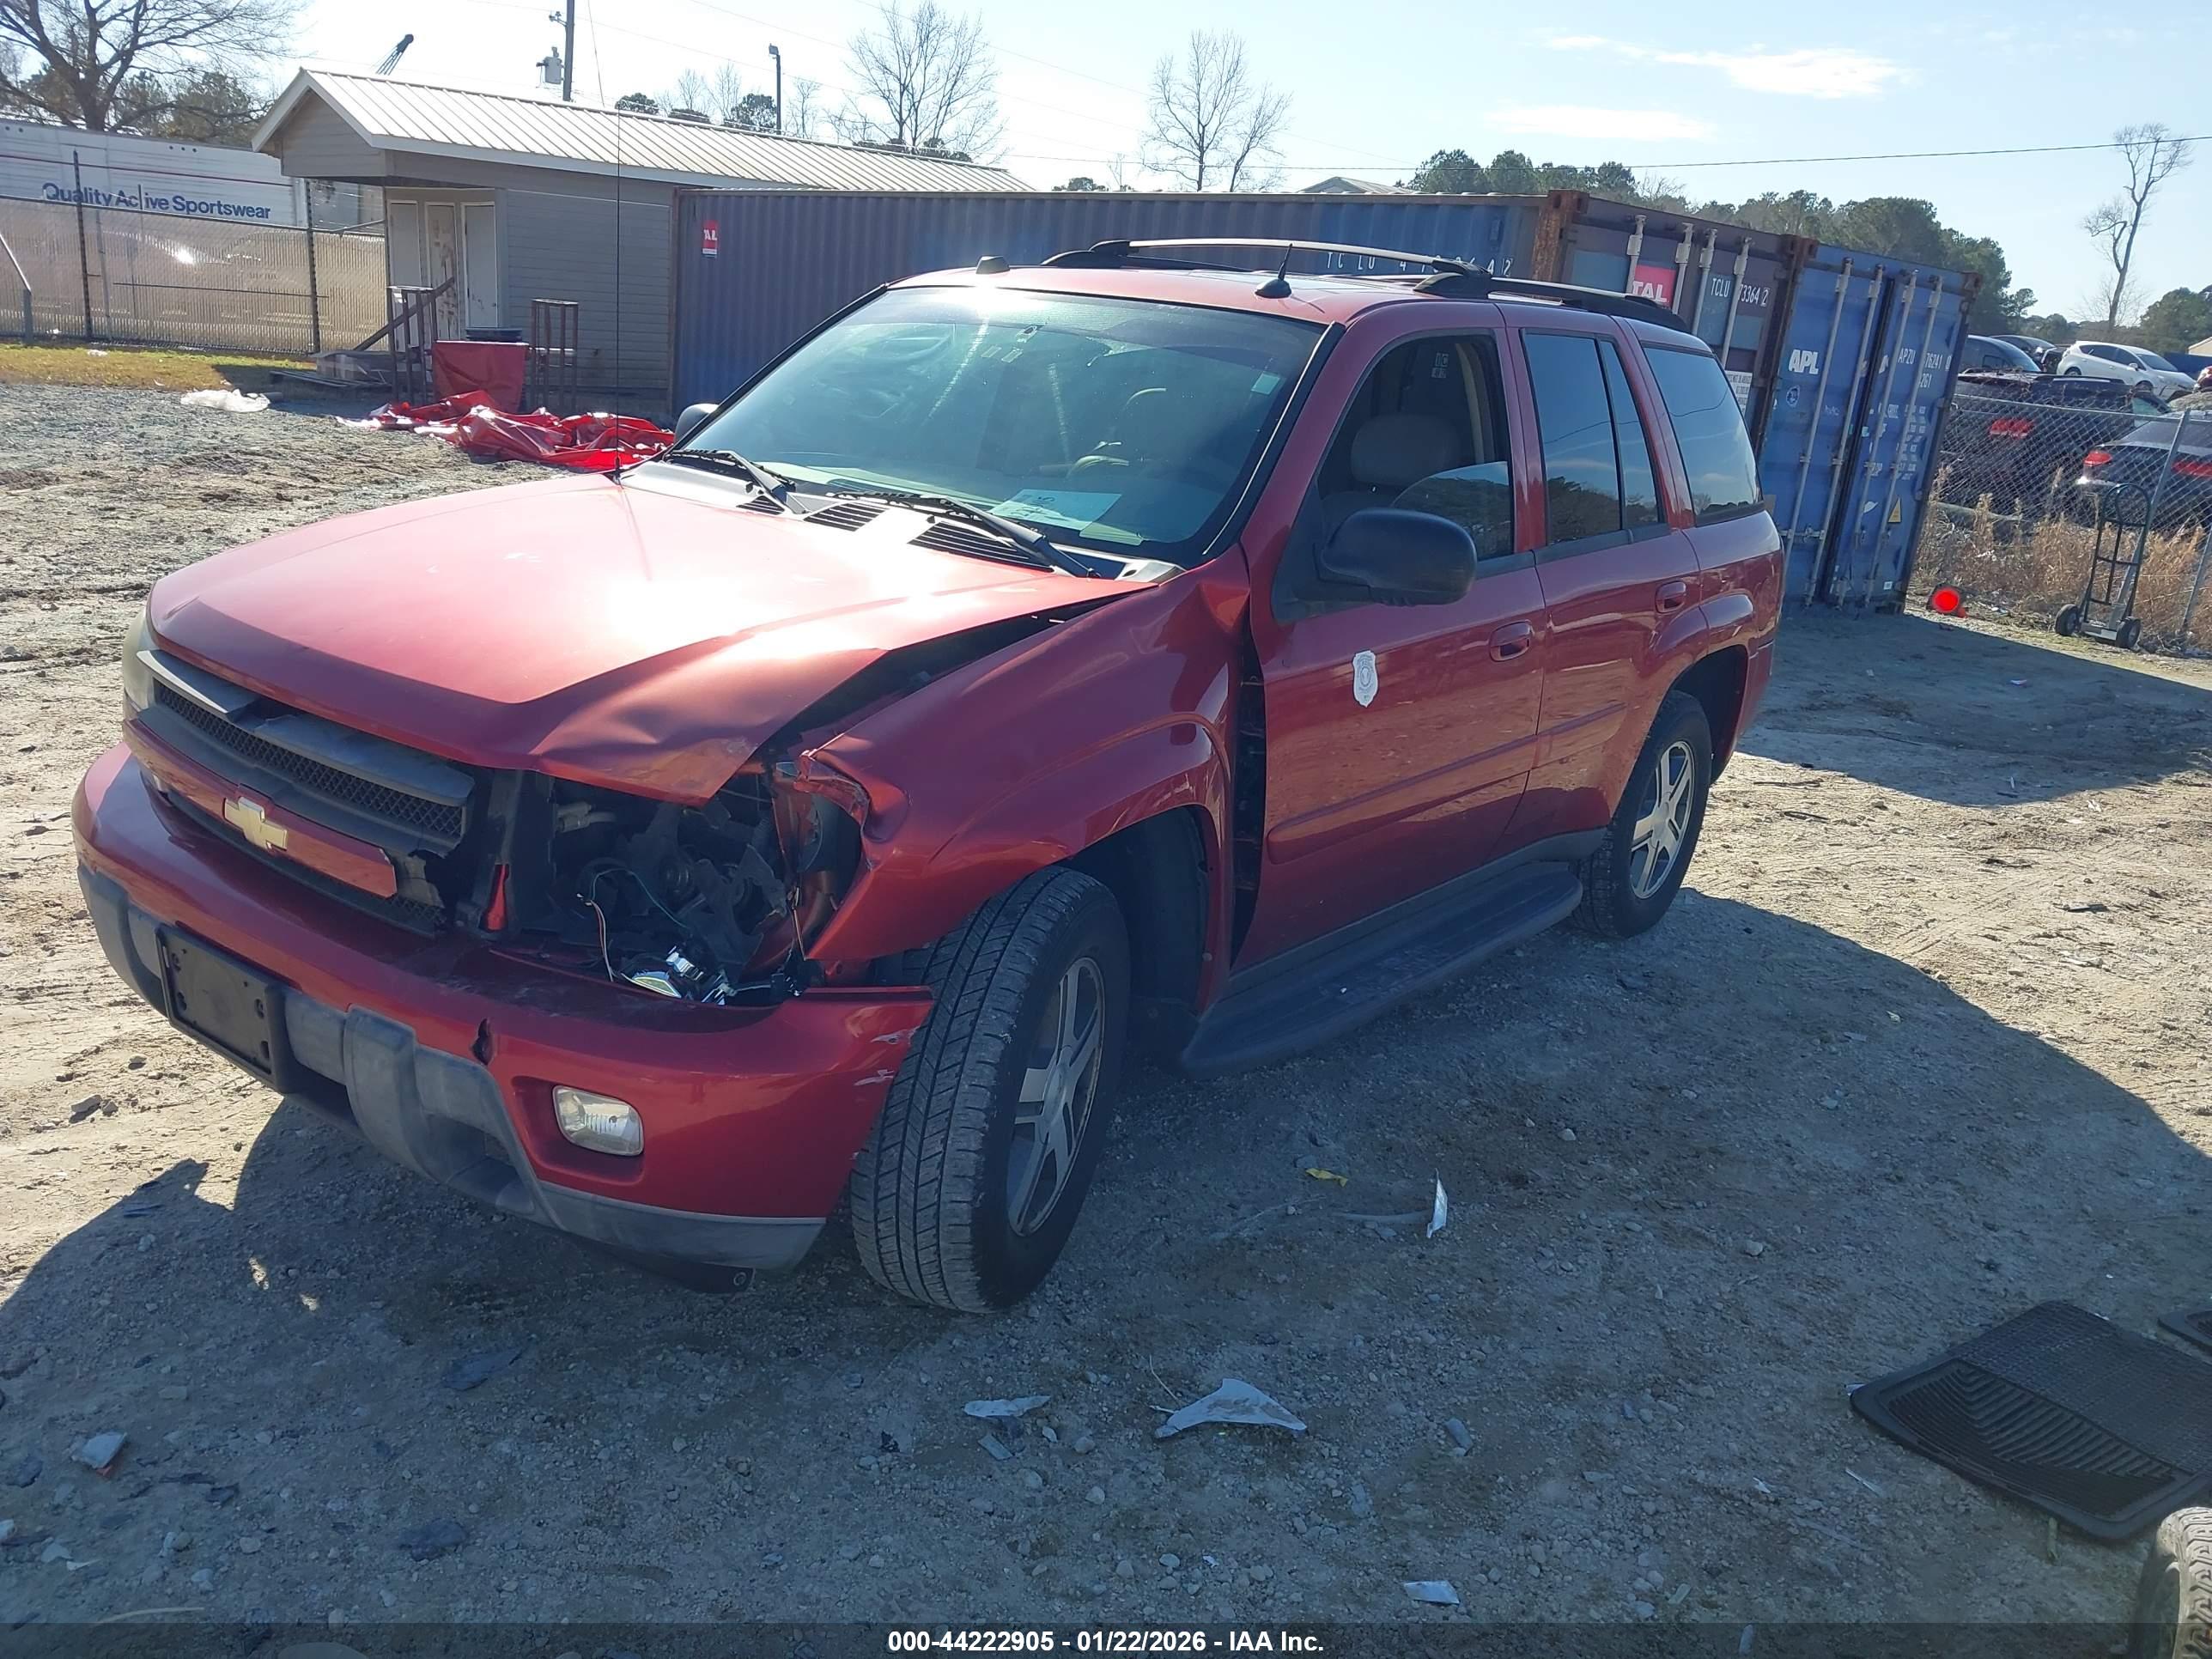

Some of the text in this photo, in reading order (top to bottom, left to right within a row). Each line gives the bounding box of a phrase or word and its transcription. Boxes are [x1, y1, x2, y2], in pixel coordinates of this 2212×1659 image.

[42, 182, 271, 220] Quality Acive Sportswear
[1632, 281, 1668, 303] TAL
[1711, 277, 1732, 298] TCLU
[1789, 349, 1820, 375] APL
[1898, 348, 1916, 365] APZU
